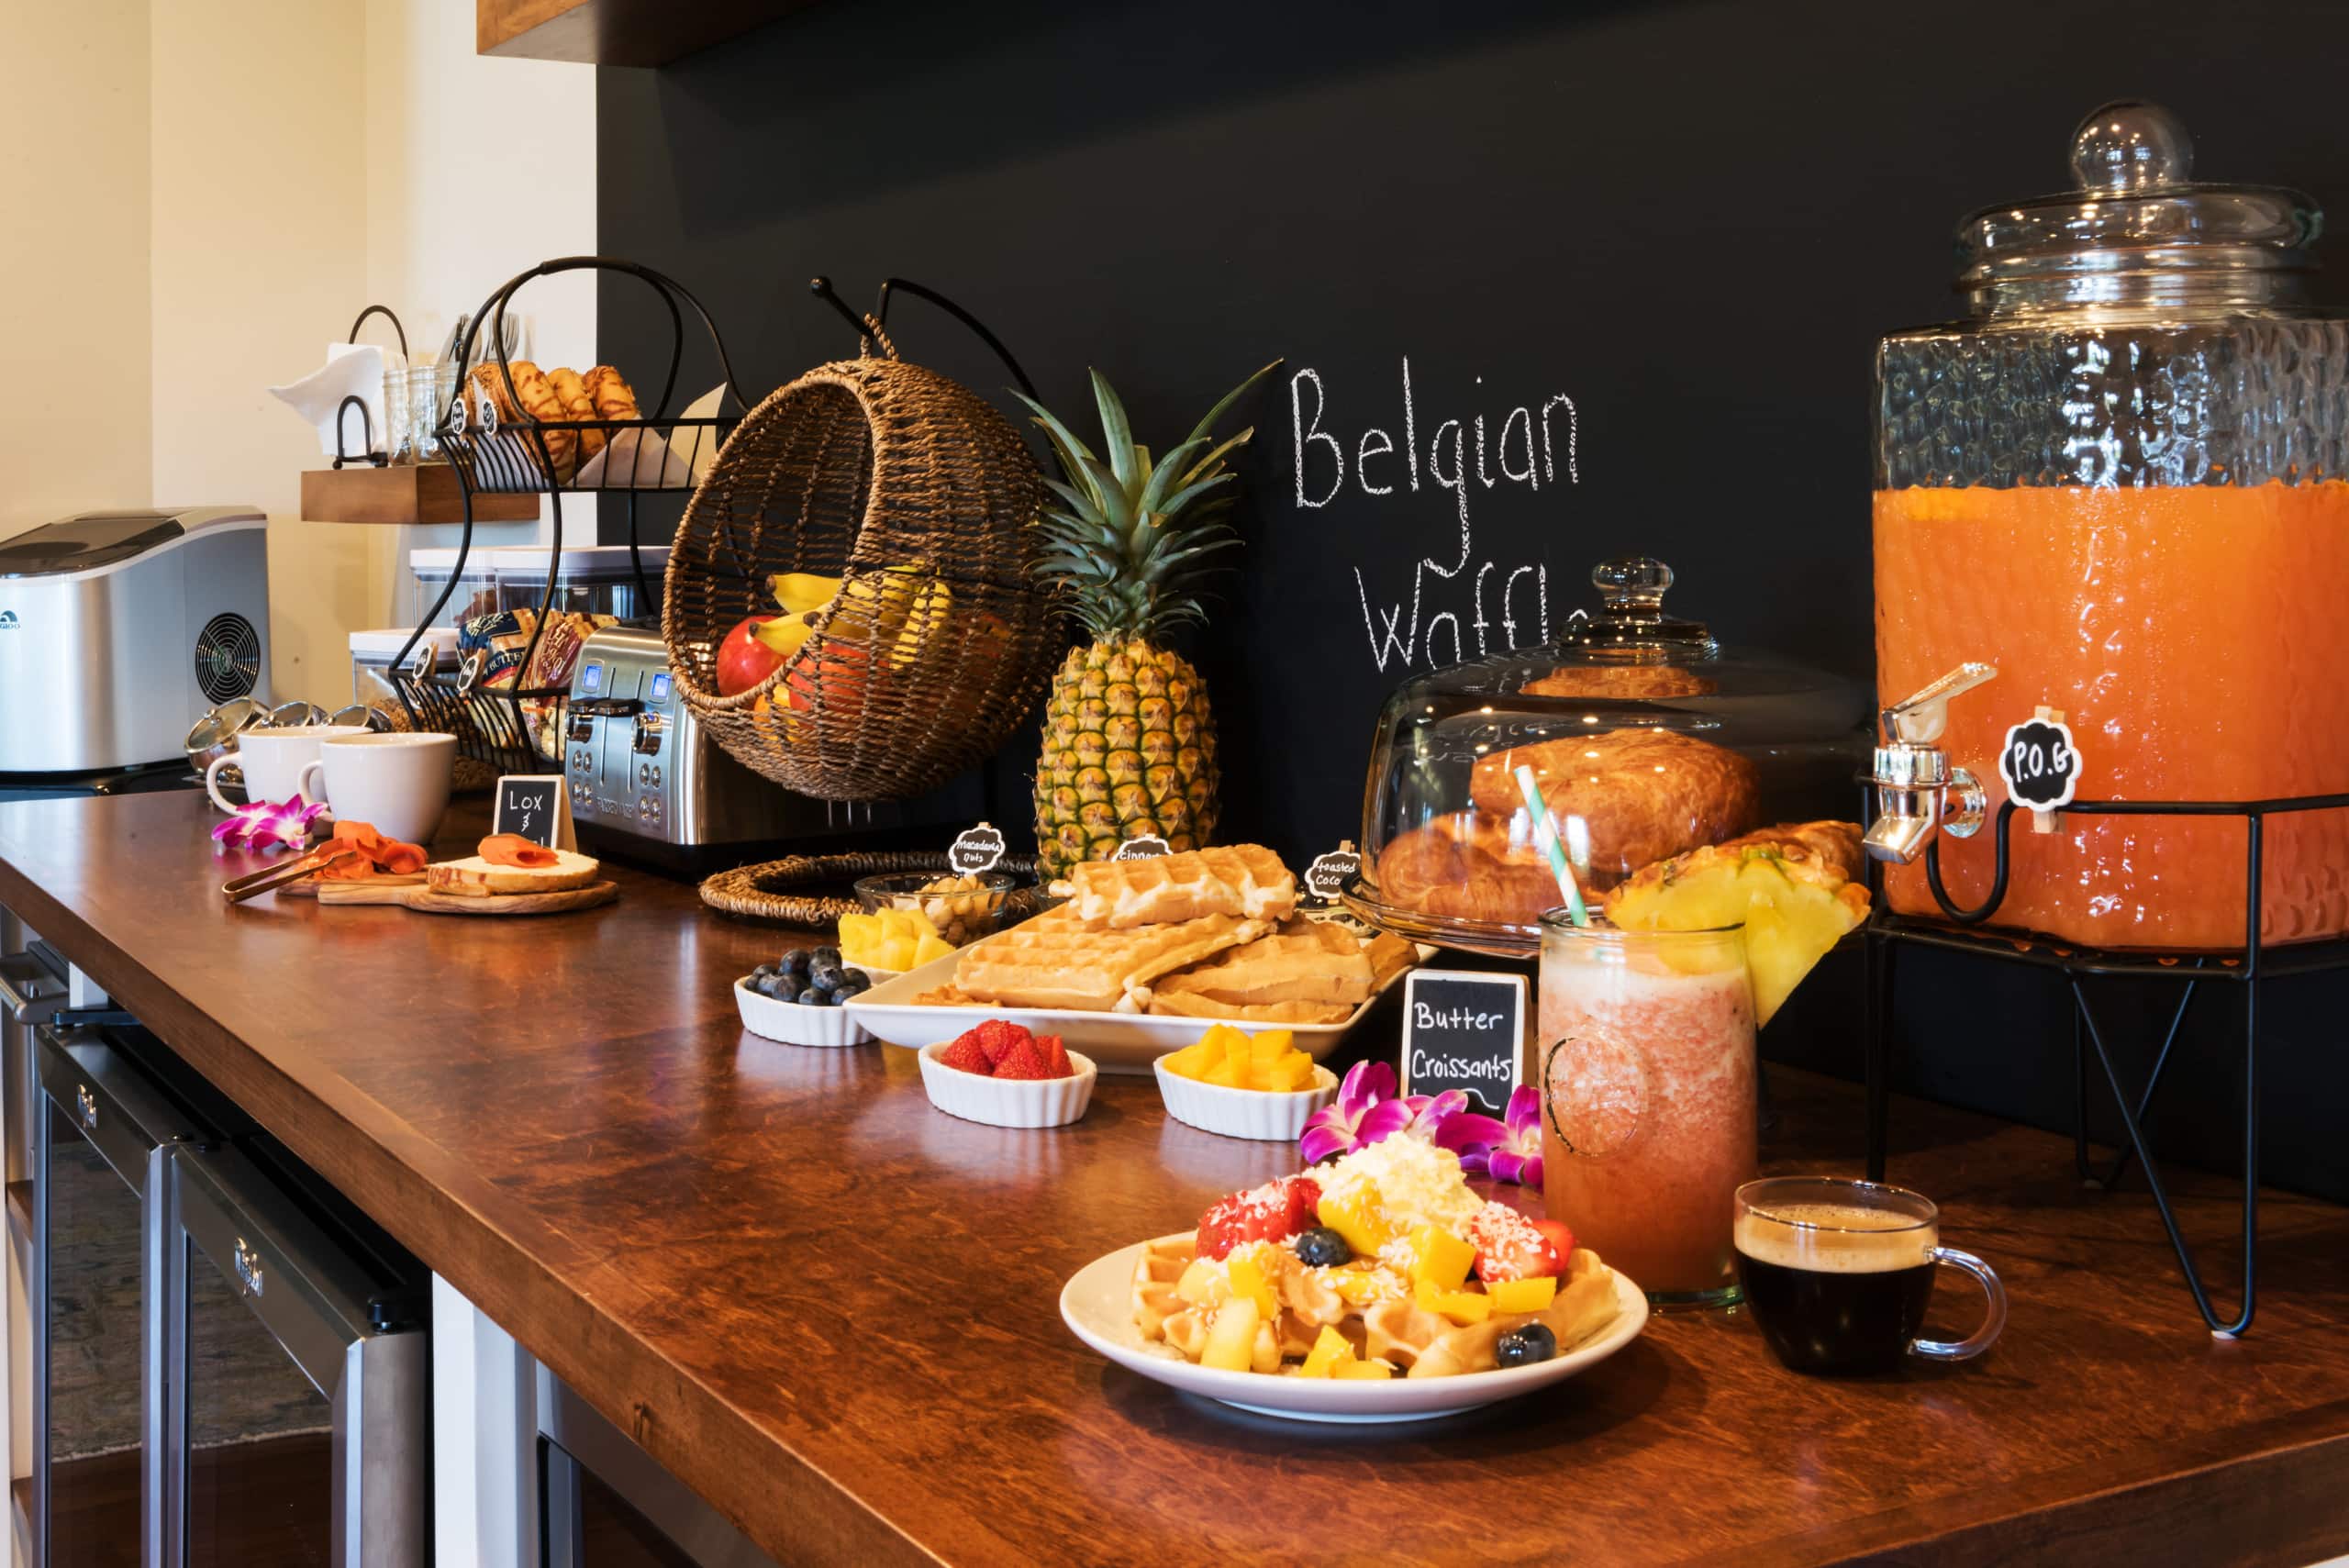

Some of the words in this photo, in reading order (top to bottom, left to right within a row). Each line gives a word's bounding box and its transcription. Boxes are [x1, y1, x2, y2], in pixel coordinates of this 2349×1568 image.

[1291, 354, 1579, 578] Belgian
[1353, 561, 1589, 673] Waffl
[489, 651, 526, 671] BUTTE
[1319, 861, 1356, 873] toasted
[1414, 1002, 1504, 1030] Butter
[1411, 1049, 1513, 1082] Croissants
